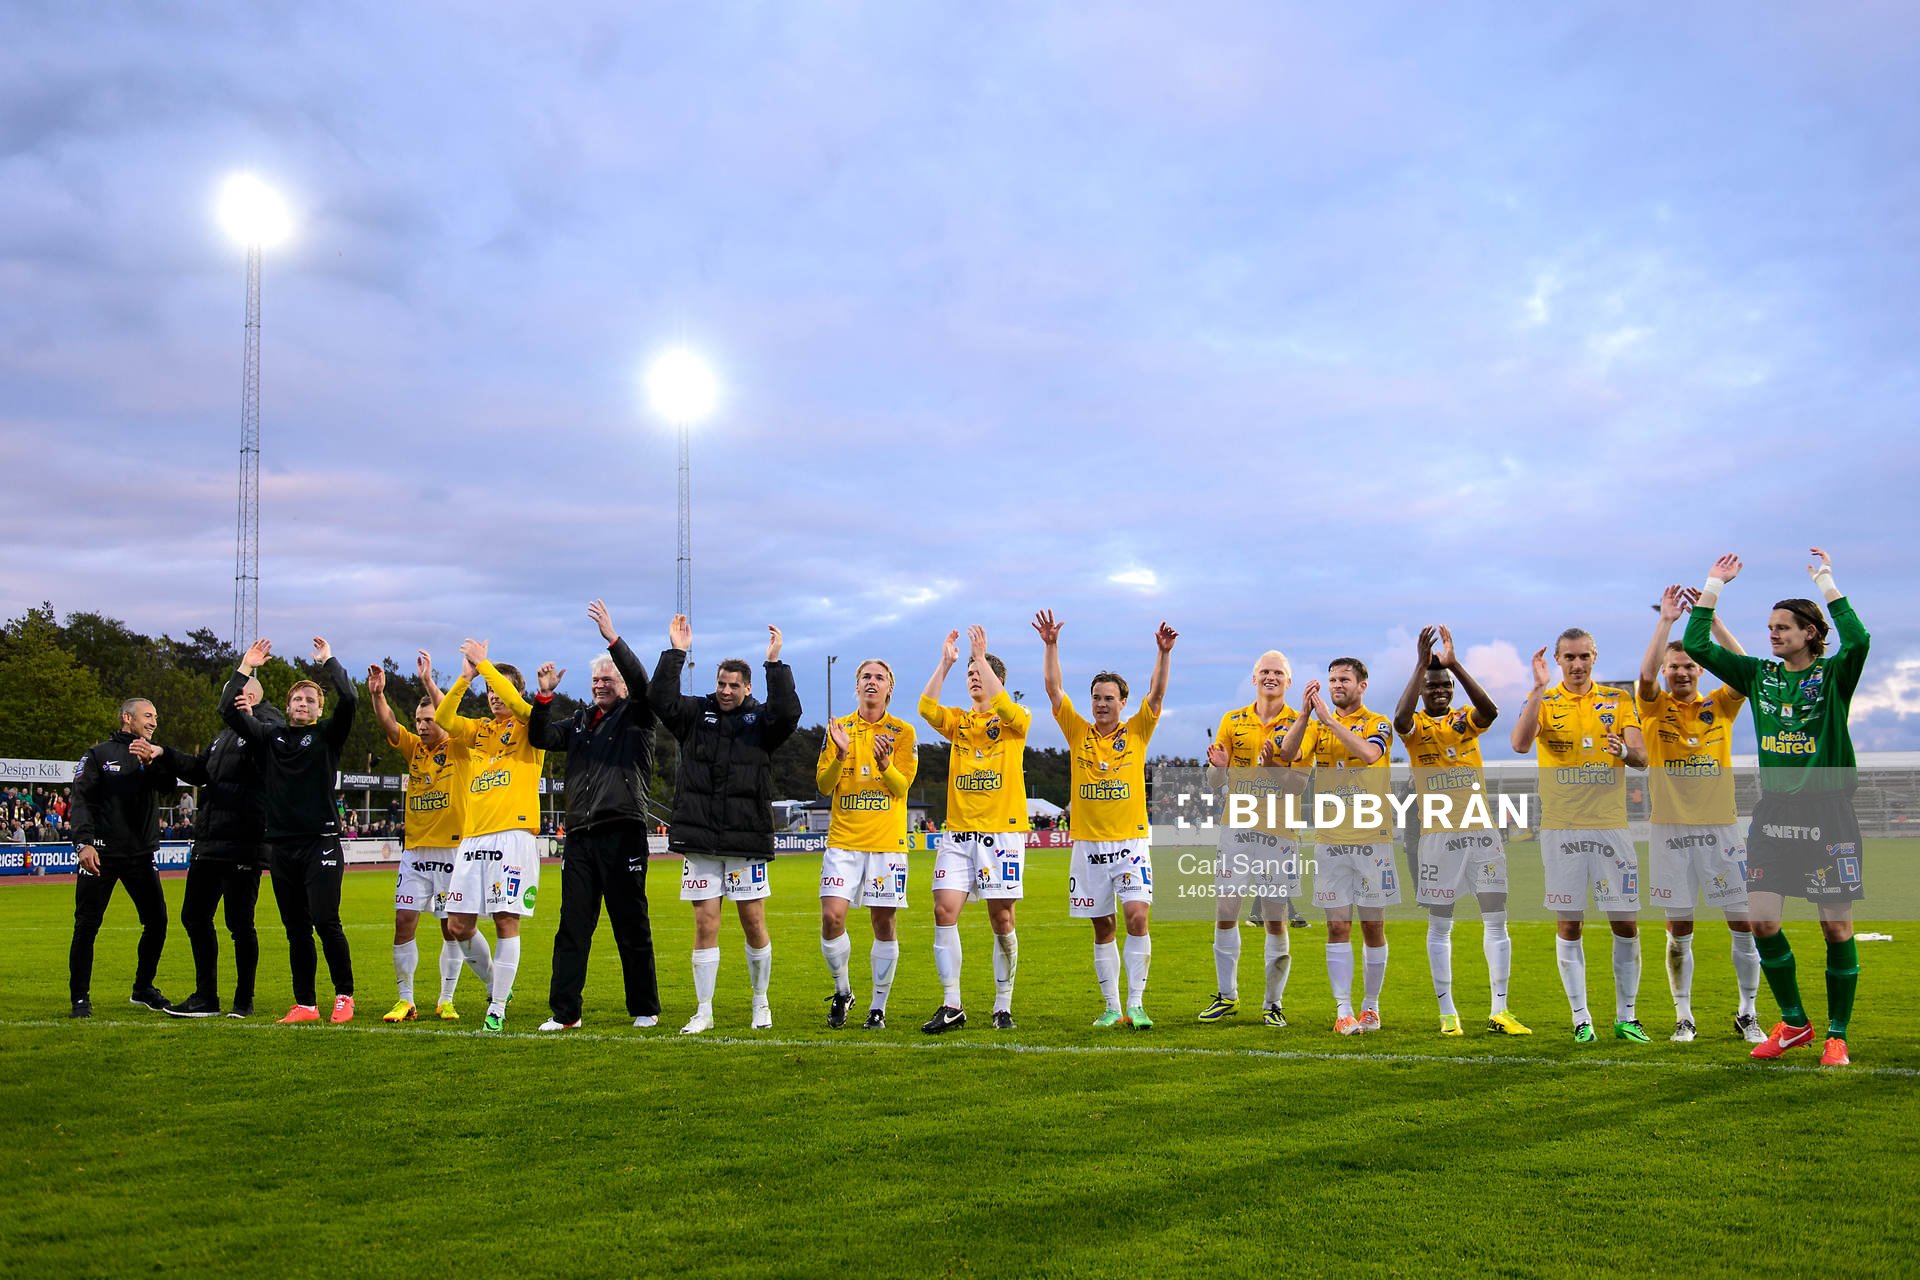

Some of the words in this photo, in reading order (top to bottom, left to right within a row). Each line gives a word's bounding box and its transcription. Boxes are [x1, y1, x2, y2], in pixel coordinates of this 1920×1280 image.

[1761, 735, 1817, 754] Ullared
[1778, 731, 1807, 742] Gekås
[39, 763, 61, 776] Kök
[1556, 767, 1616, 784] Ullared
[1664, 759, 1721, 777] Ullared
[956, 773, 1003, 790] Ullared
[1427, 770, 1480, 791] Ullared
[1080, 783, 1130, 800] Ullared
[1235, 781, 1284, 799] Ullared
[840, 794, 890, 811] Ullared
[957, 831, 994, 848] NETTO
[1242, 832, 1278, 847] NETTO
[1674, 834, 1717, 848] NETTO
[1774, 825, 1821, 841] NETTO
[1334, 844, 1374, 857] NETTO
[1453, 836, 1493, 850] NETTO
[1567, 841, 1615, 858] NETTO
[1093, 849, 1131, 865] NETTO
[418, 861, 454, 874] NETTO
[1421, 864, 1439, 882] 22
